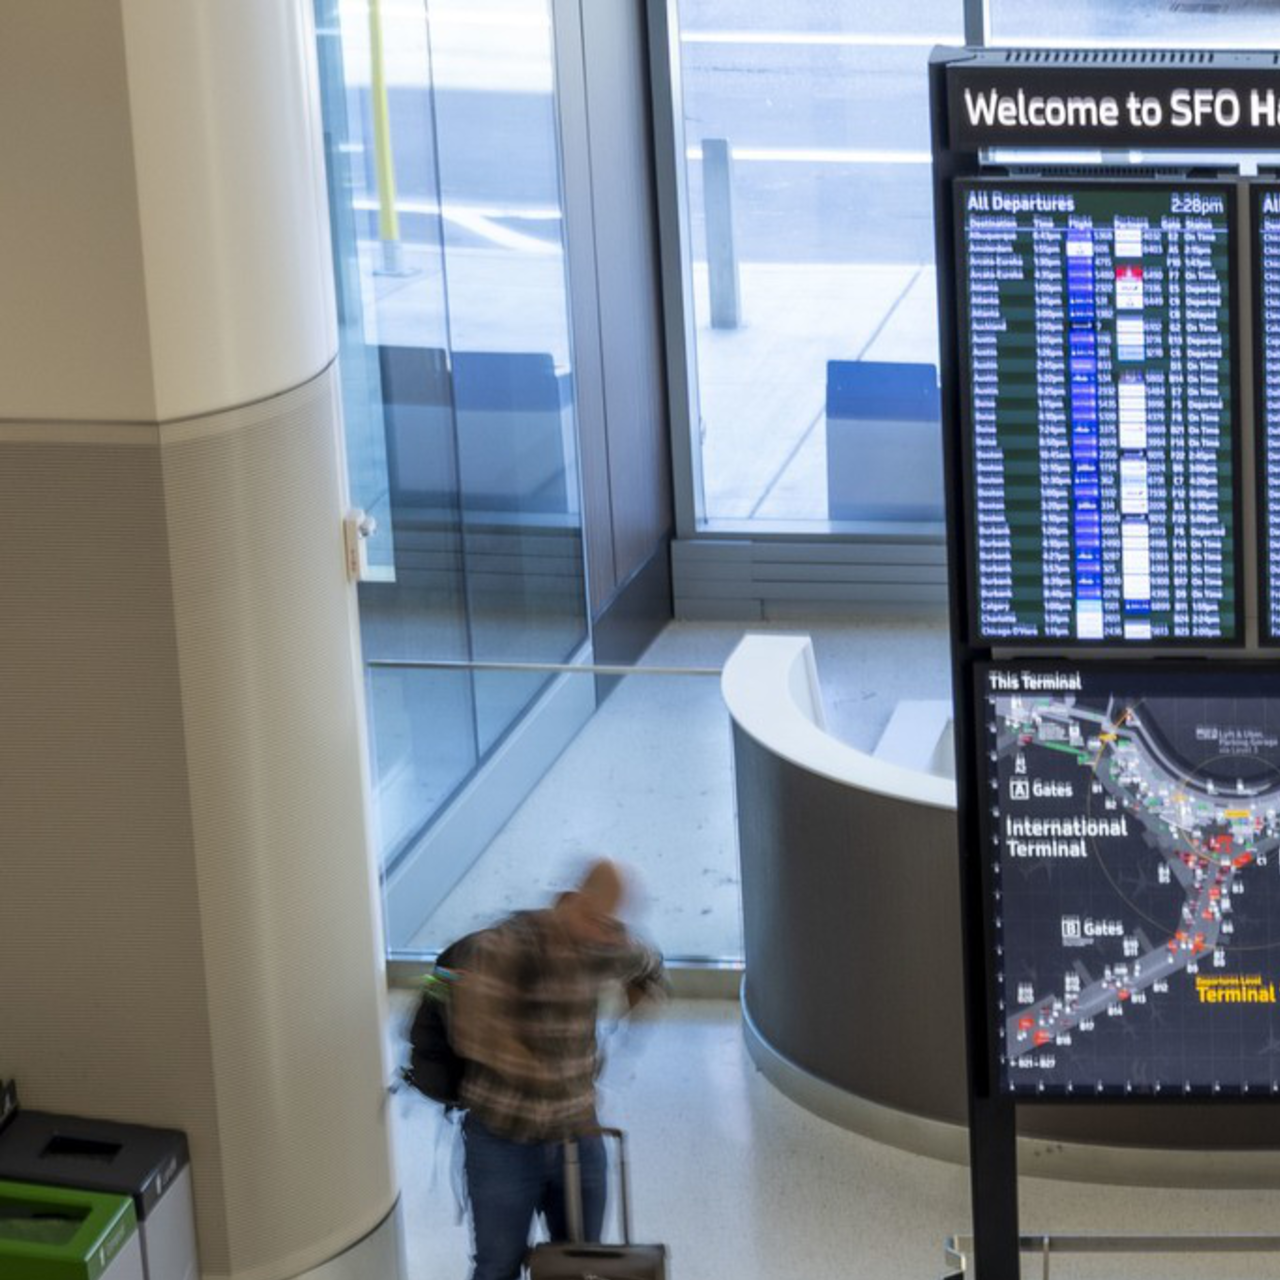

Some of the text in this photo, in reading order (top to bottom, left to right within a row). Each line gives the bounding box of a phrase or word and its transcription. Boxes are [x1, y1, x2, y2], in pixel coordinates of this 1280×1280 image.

[964, 89, 1119, 126] Welcome
[1127, 92, 1162, 126] to
[1170, 89, 1240, 126] SFO
[968, 194, 1074, 213] All Departures
[1171, 197, 1224, 215] 2:28pm
[988, 675, 1082, 690] This Terminal
[1012, 781, 1073, 797] A Gates
[1006, 818, 1128, 836] International
[1006, 841, 1087, 857] Terminal
[1064, 920, 1124, 937] B Gates
[1197, 985, 1276, 1003] Terminal
